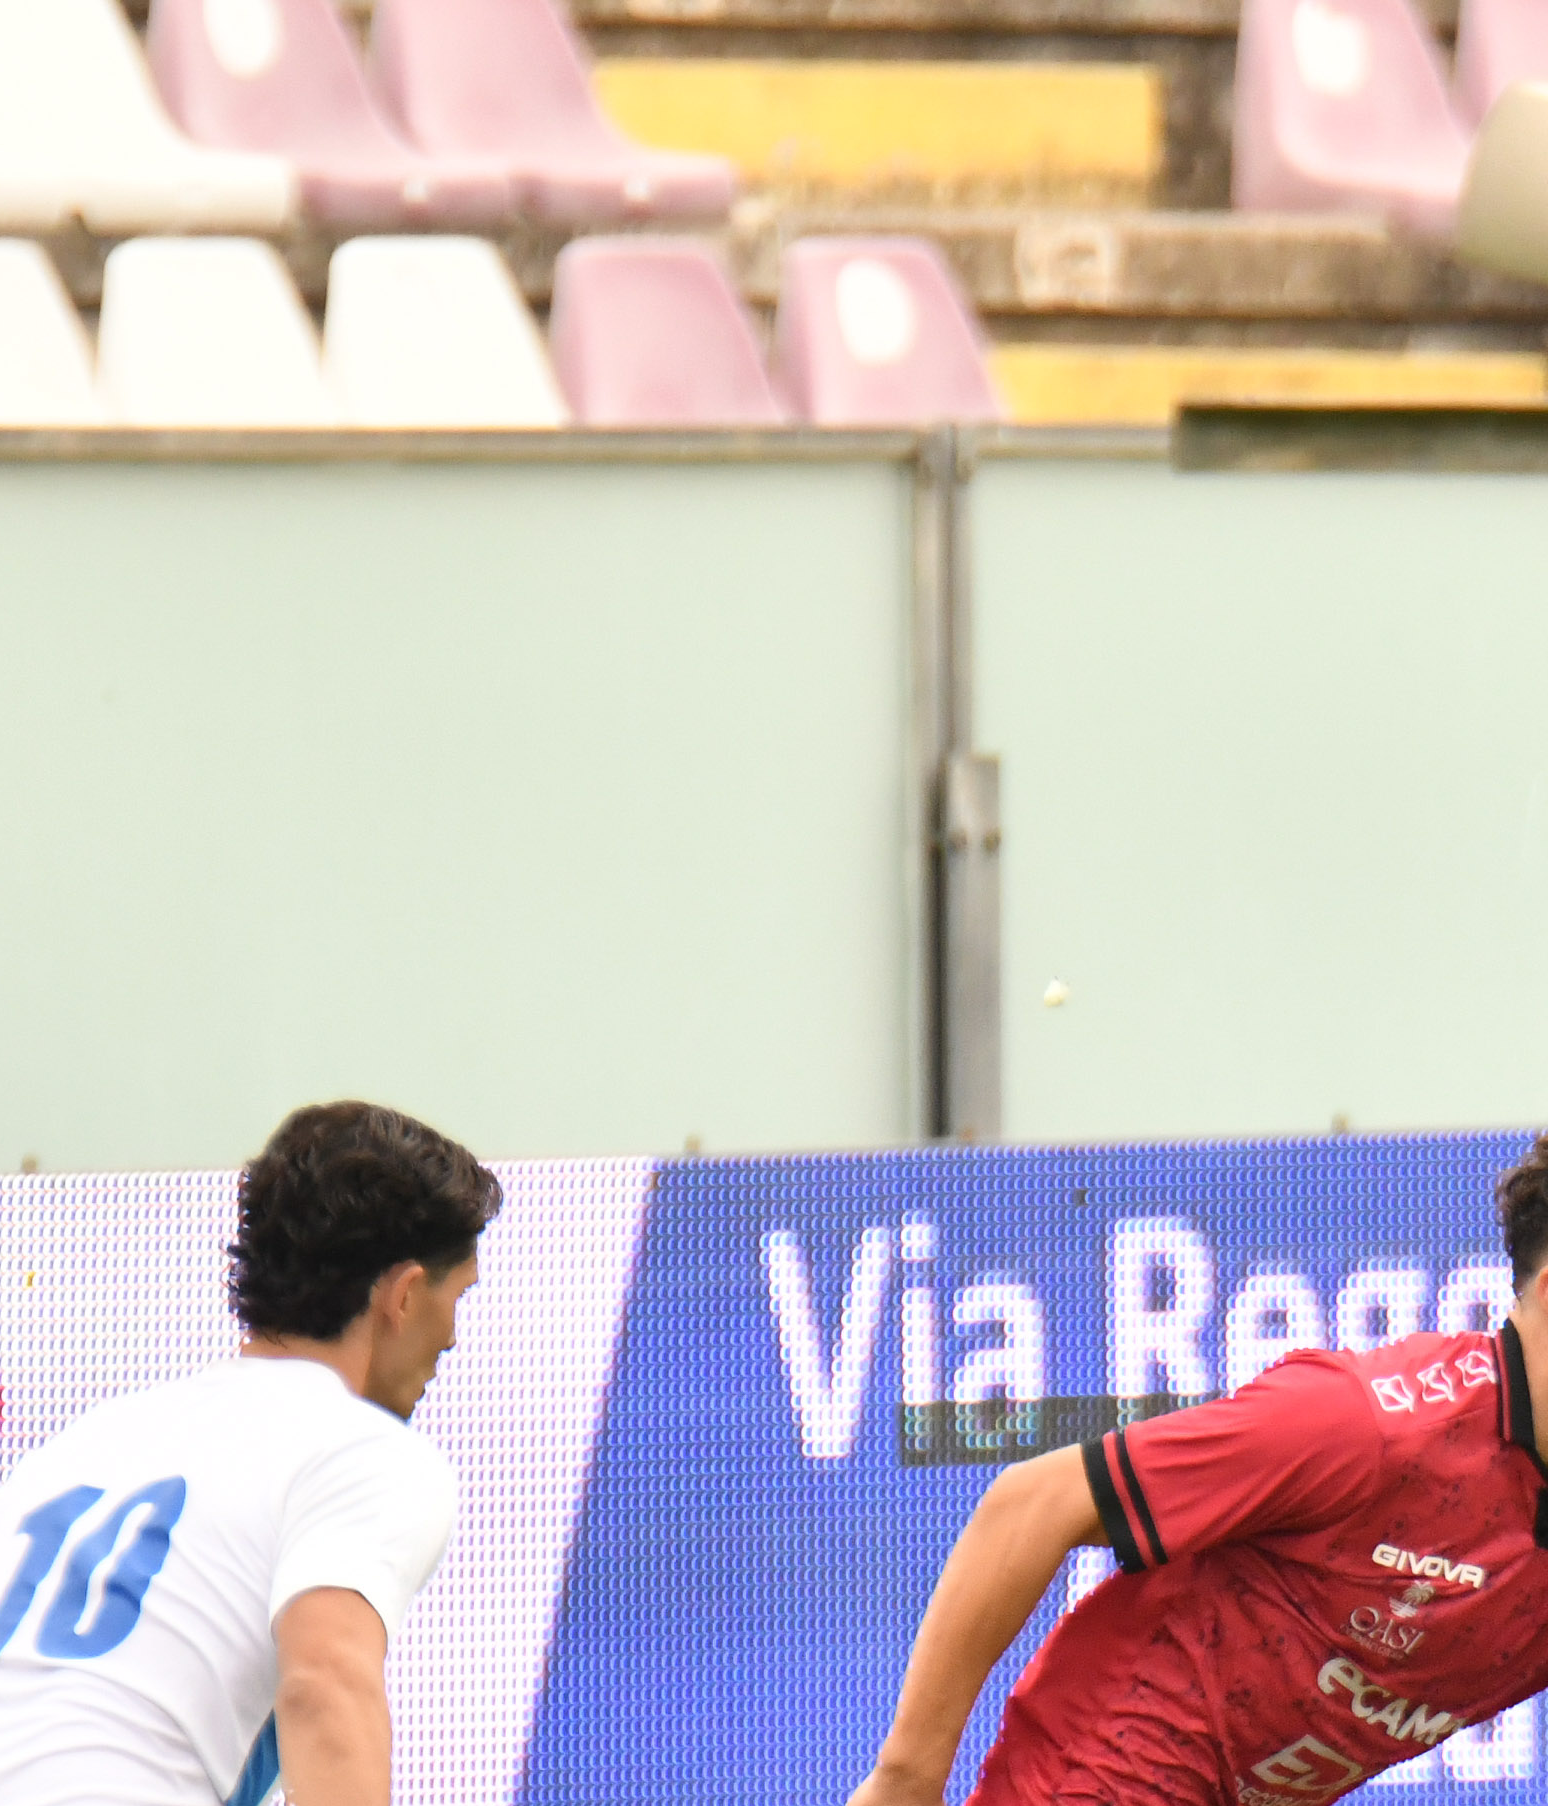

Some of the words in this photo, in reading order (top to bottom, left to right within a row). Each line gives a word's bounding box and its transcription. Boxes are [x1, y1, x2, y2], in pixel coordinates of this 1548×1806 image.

[760, 1209, 1046, 1456] Via
[1371, 1543, 1486, 1589] GIVOVA
[1349, 1605, 1426, 1654] OASI
